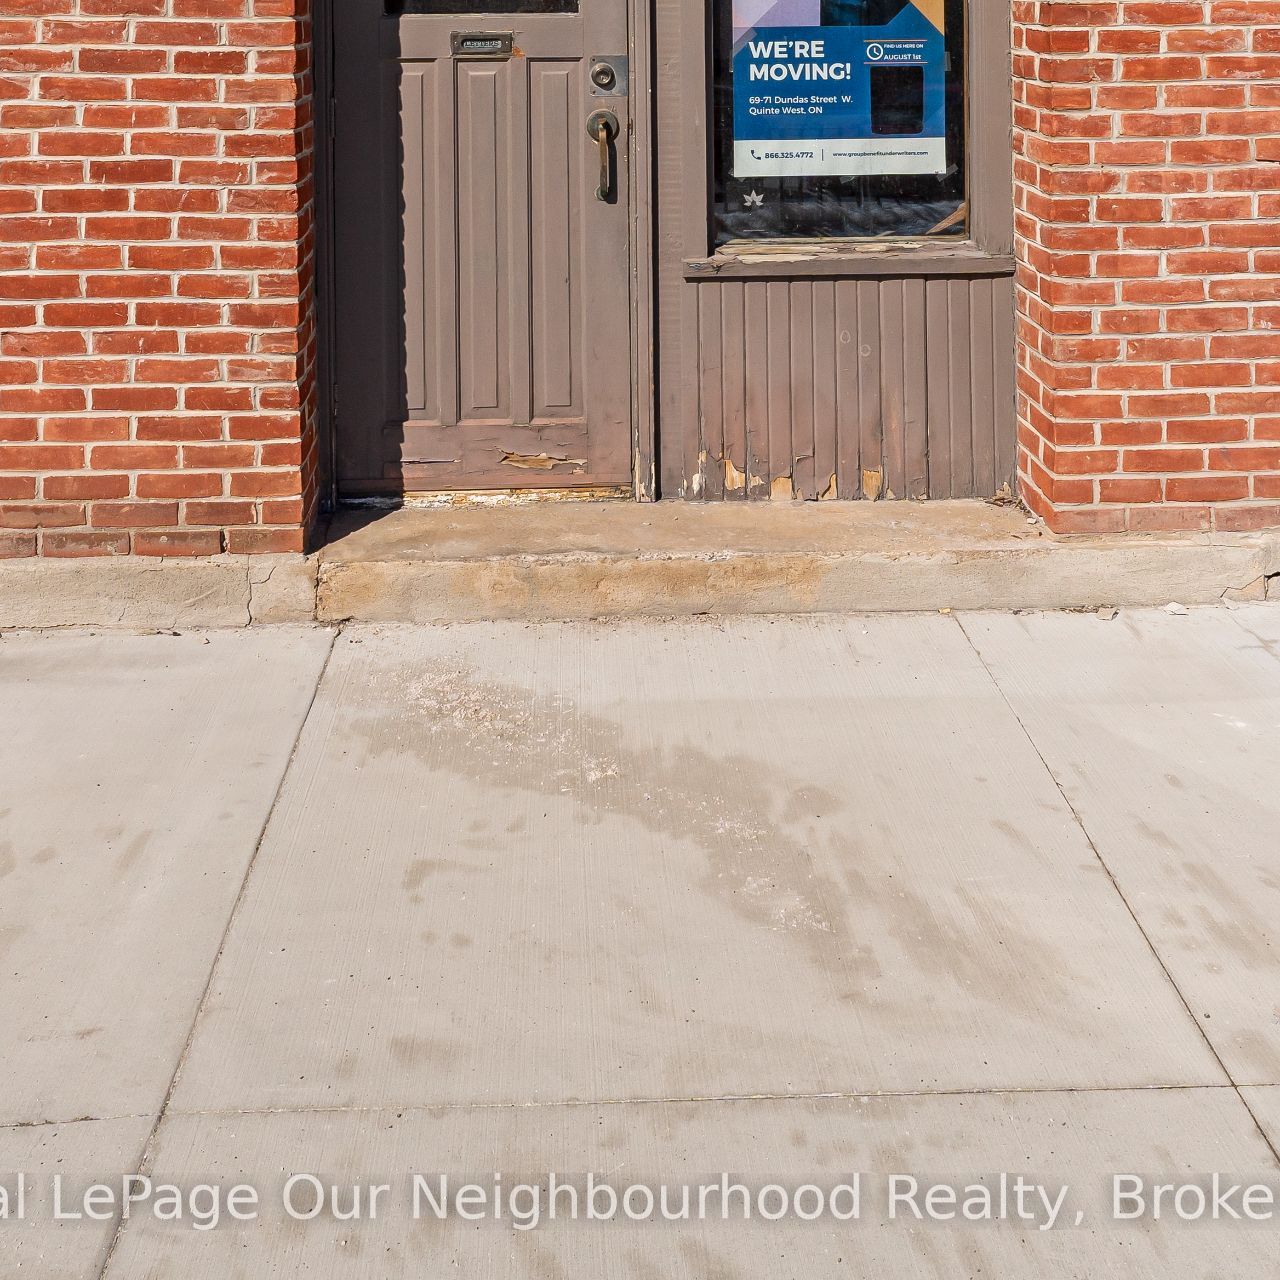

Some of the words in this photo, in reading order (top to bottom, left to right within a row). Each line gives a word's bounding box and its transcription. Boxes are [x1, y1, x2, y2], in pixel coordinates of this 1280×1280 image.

[748, 40, 825, 59] WE'RE
[883, 53, 911, 61] AUGUST
[749, 62, 852, 81] MOVING!
[748, 96, 772, 104] 69-71
[774, 95, 809, 104] Dundas
[810, 95, 838, 104] Street
[841, 95, 854, 103] W.
[748, 106, 780, 116] Quinte
[807, 106, 823, 114] ON
[764, 151, 814, 159] 866.325.4772
